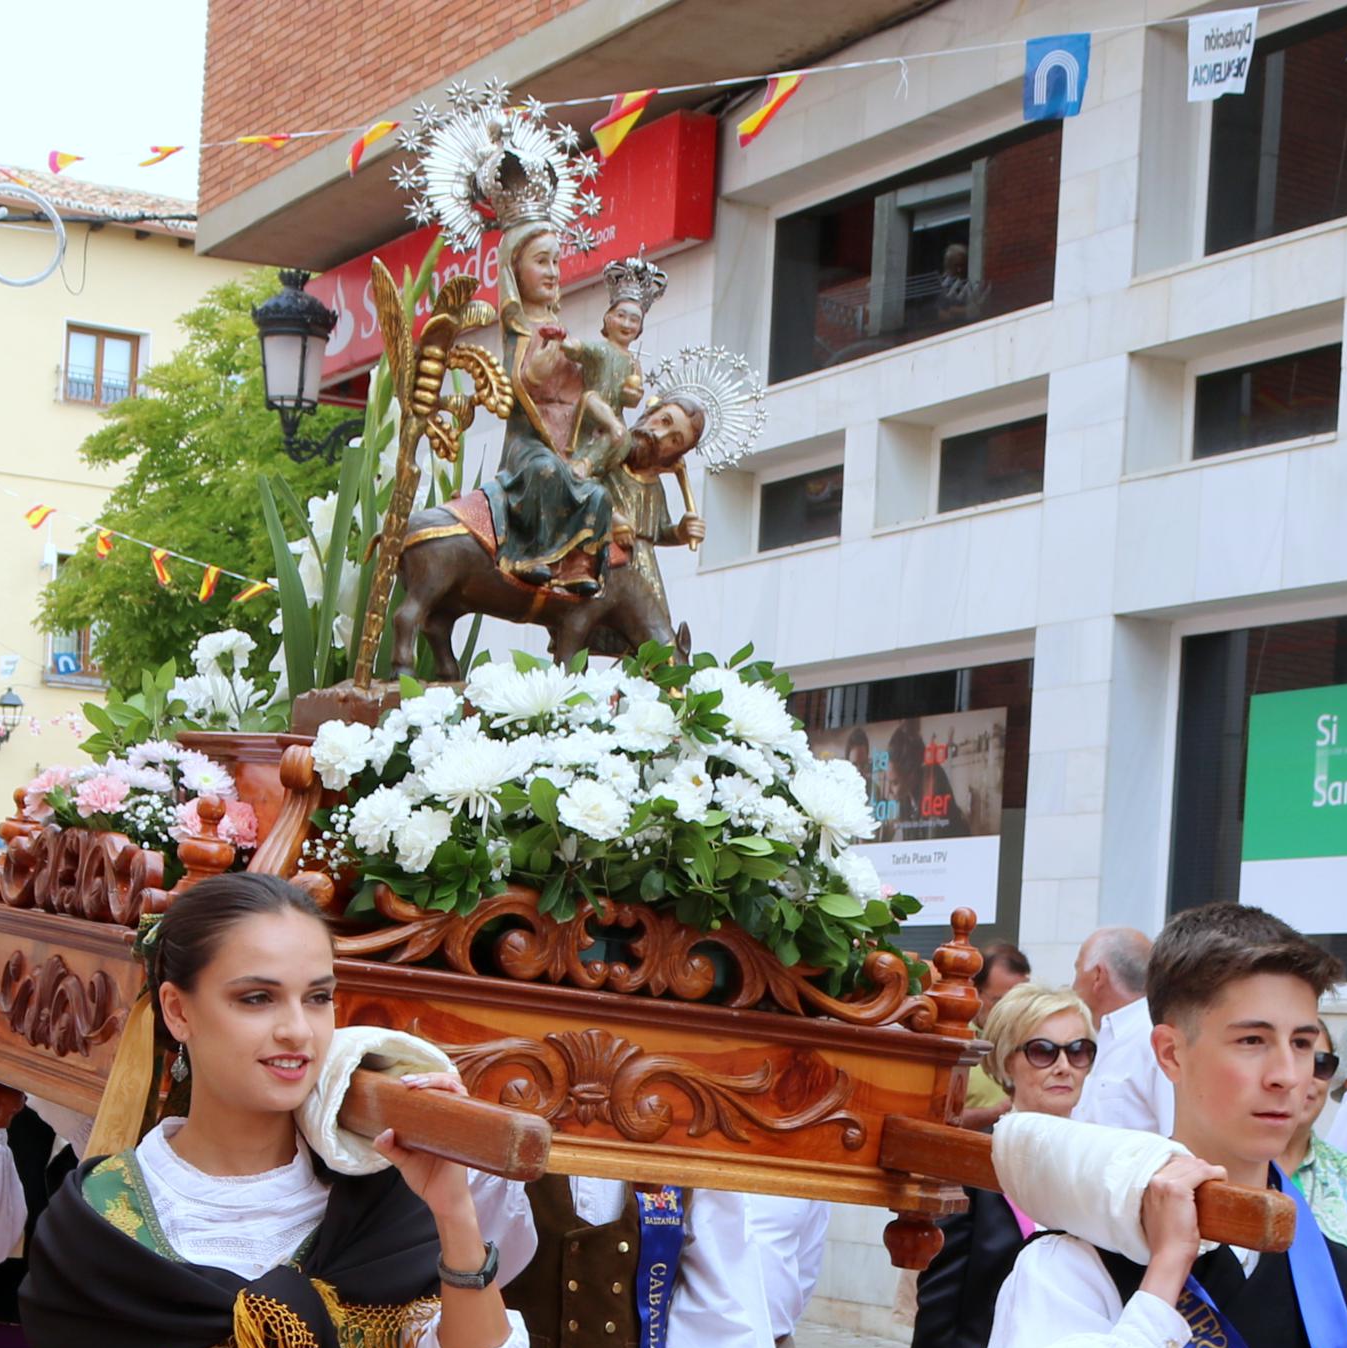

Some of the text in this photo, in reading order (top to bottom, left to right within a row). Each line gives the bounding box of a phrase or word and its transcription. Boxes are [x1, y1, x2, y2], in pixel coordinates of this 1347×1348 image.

[1316, 713, 1339, 747] Si
[892, 851, 948, 866] Tarifa Plana TPV
